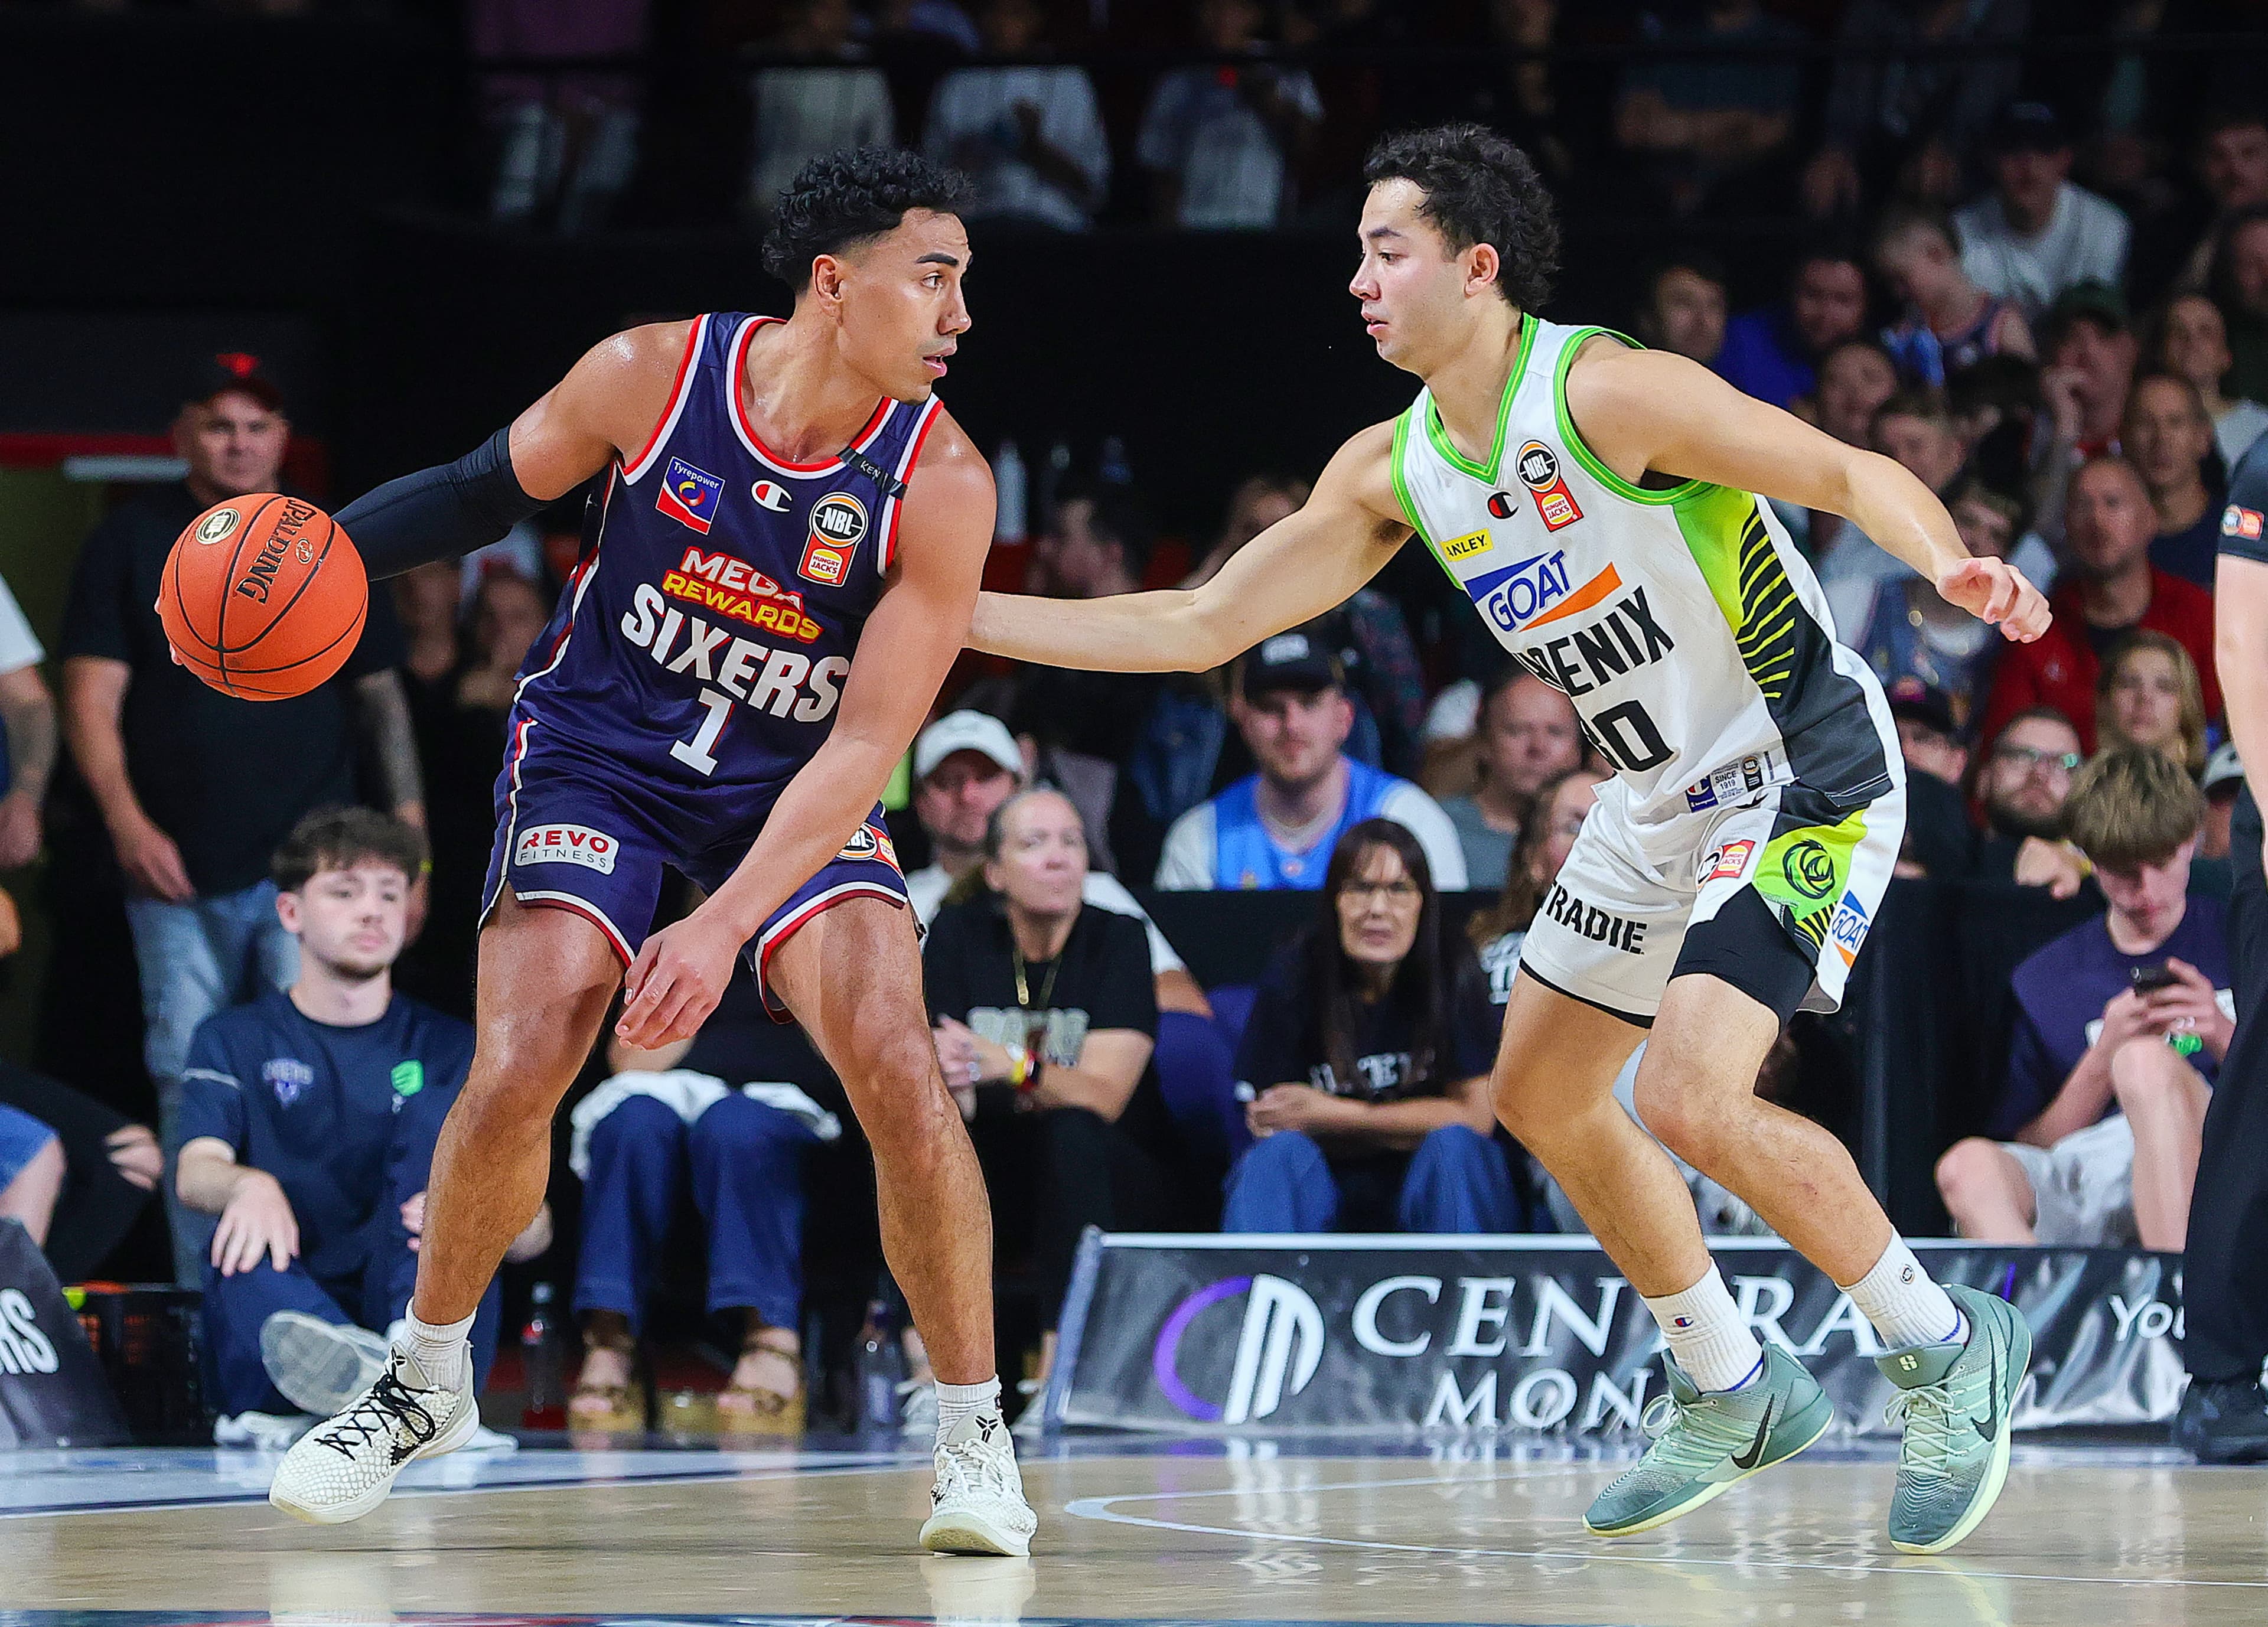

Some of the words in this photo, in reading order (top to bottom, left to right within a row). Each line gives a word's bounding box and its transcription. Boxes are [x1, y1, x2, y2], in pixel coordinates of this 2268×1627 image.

[674, 461, 719, 490] Tyrepower
[1523, 453, 1552, 481] NBL
[821, 507, 853, 536] NBL
[810, 561, 838, 574] JACK'S
[813, 555, 840, 566] HUNGRY
[681, 550, 802, 611] MEGA
[1488, 549, 1571, 632] GOAT
[662, 572, 823, 640] REWARDS
[621, 583, 850, 722] SIXERS
[1511, 585, 1675, 697] HOENIX
[669, 687, 734, 777] 1
[1715, 770, 1736, 784] SINCE
[1720, 779, 1736, 790] 1919
[522, 830, 609, 853] REVO
[846, 830, 870, 848] BL
[520, 849, 607, 868] FITNESS
[1832, 908, 1869, 950] GOAT
[1351, 1274, 1887, 1358] CENRA
[1422, 1367, 1654, 1430] MON
